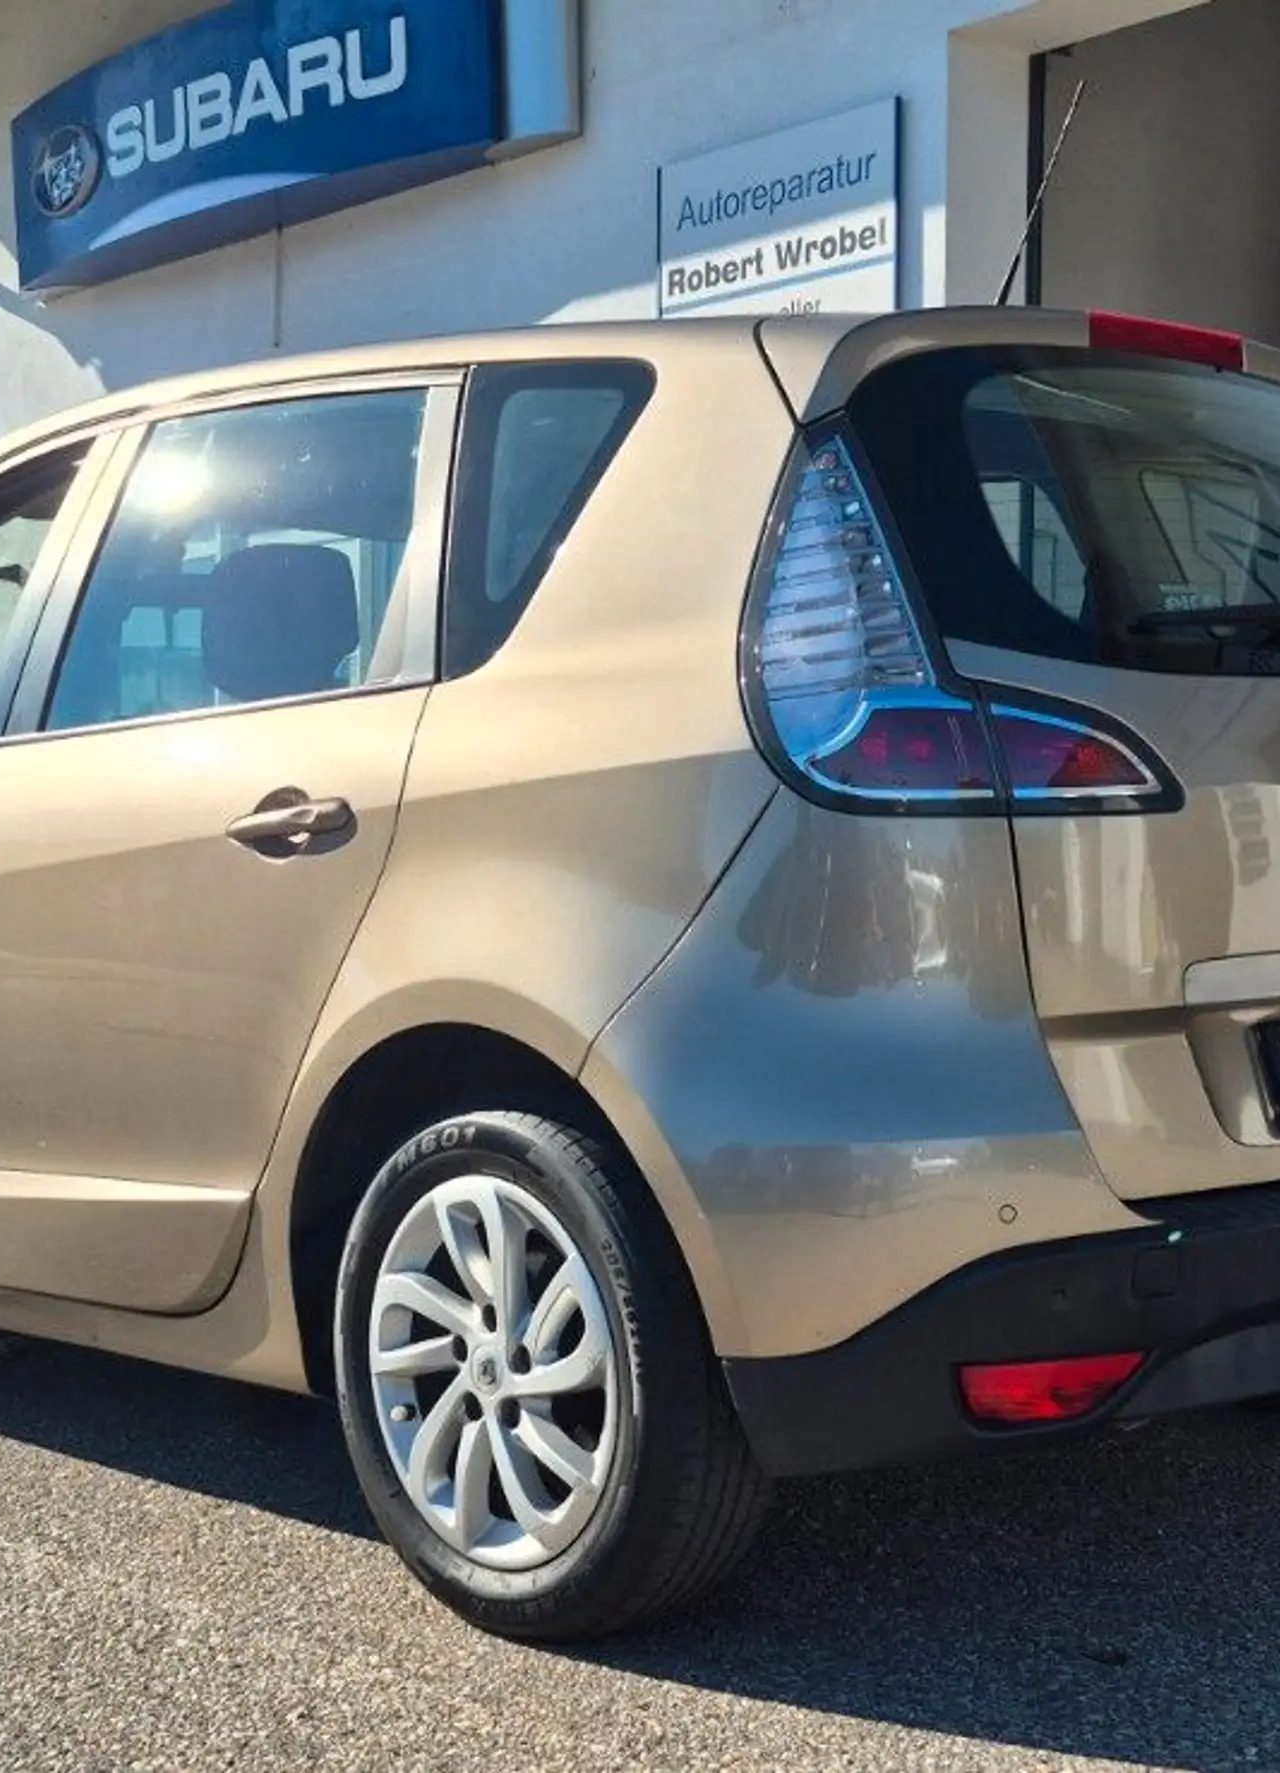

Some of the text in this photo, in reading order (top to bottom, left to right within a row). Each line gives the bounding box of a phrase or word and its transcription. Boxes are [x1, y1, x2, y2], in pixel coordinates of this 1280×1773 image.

[104, 15, 408, 178] SUBARU
[676, 151, 877, 231] Autoreparatur
[667, 216, 887, 297] Robert Wrobel
